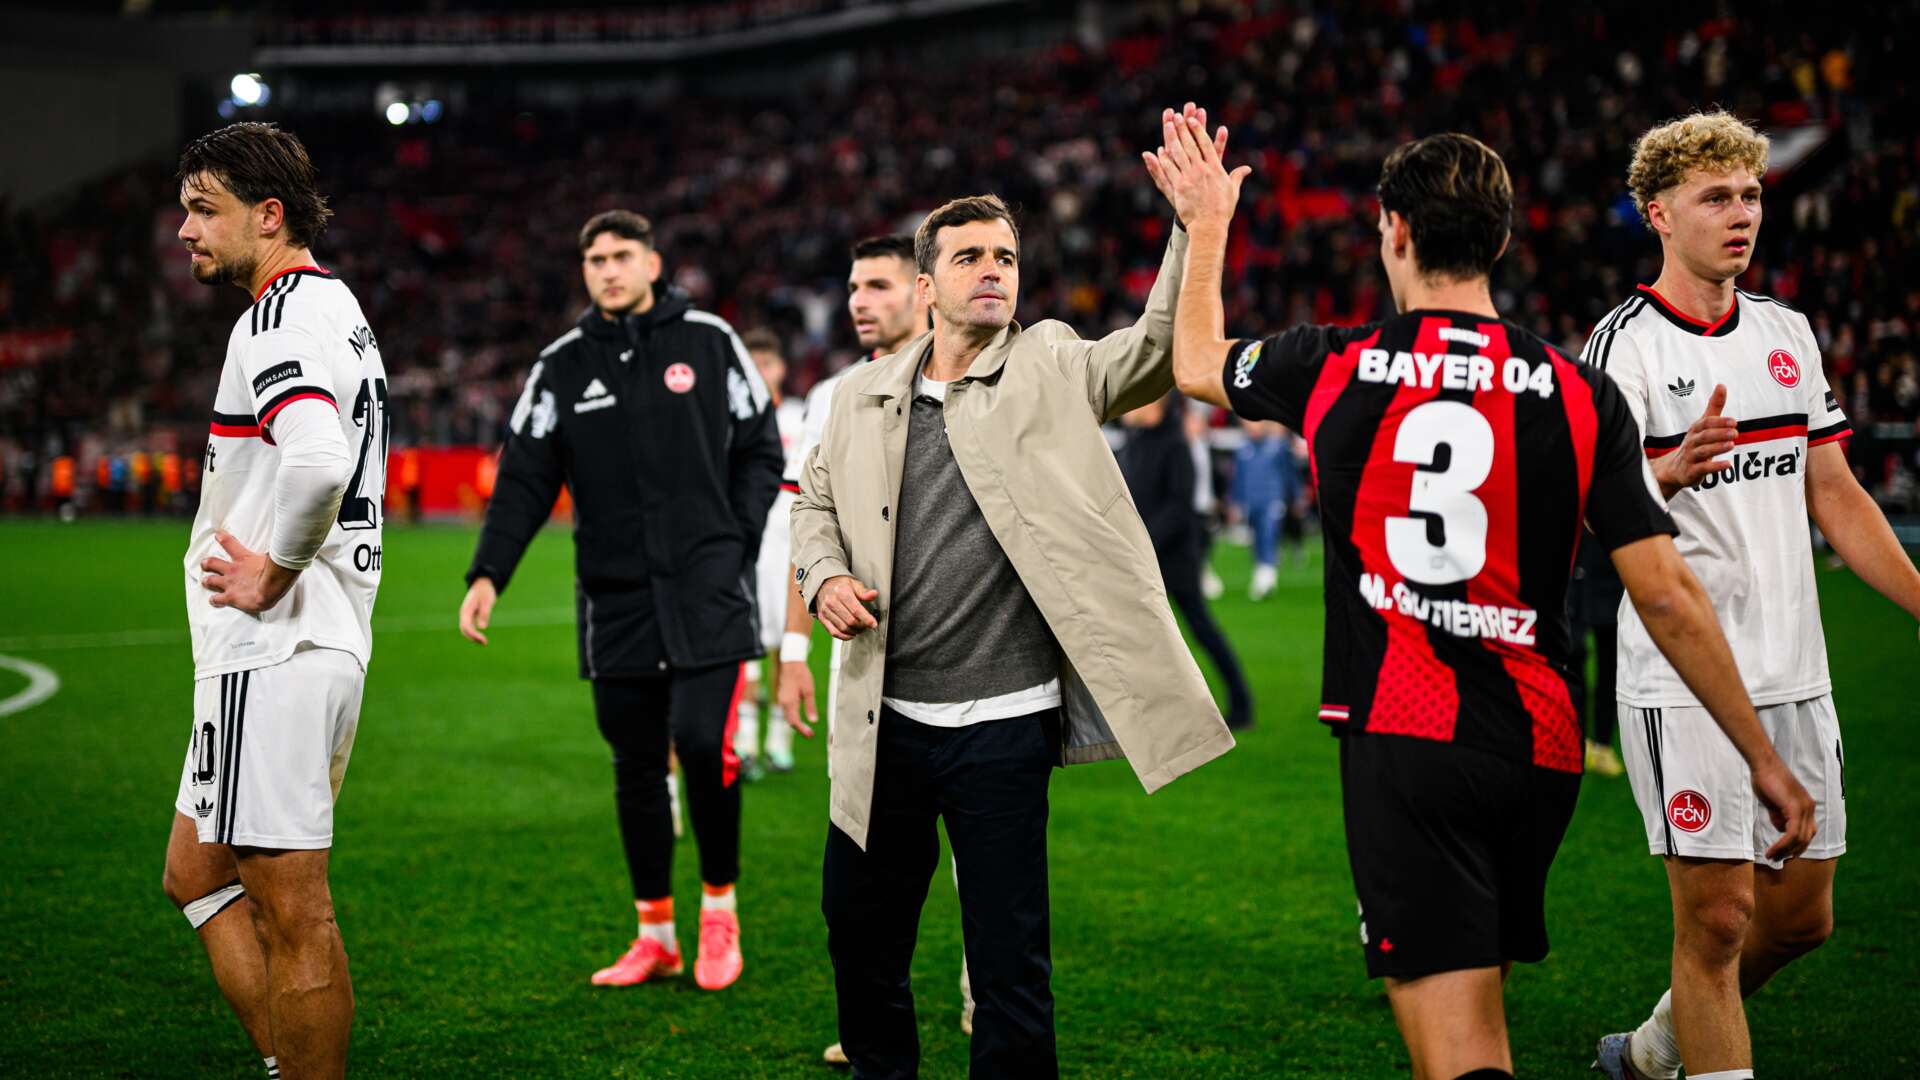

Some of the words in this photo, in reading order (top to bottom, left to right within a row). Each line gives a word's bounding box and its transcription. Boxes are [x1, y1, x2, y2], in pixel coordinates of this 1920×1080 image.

[255, 367, 298, 392] HELMSAUER
[1358, 348, 1495, 392] BAYER
[1502, 357, 1554, 398] 04
[1773, 364, 1798, 378] FCN
[1690, 446, 1800, 492] oolcra
[1385, 400, 1495, 585] 3
[192, 720, 217, 786] 0
[1673, 806, 1704, 823] FCN
[1684, 794, 1694, 808] 1.
